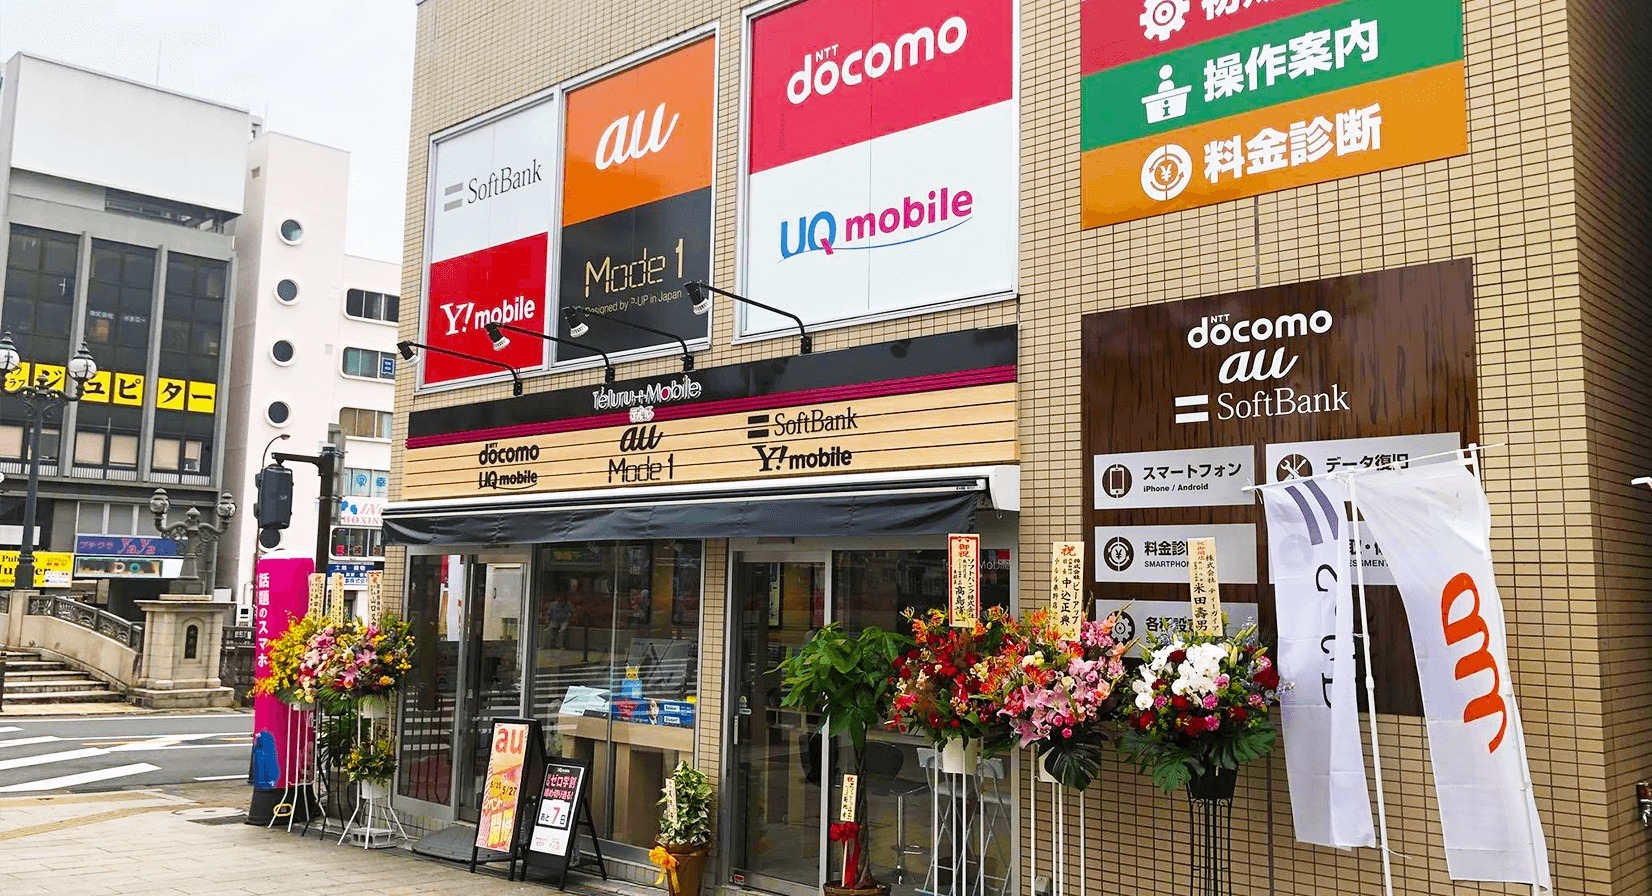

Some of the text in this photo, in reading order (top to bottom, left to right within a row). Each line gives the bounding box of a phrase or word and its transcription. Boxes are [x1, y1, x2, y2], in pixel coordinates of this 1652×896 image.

[786, 16, 968, 104] docomo
[815, 43, 839, 62] NTT
[1204, 18, 1379, 102] 操作案内
[595, 102, 680, 170] au
[1204, 103, 1382, 183] 料金診断
[467, 159, 543, 204] SoftBank
[780, 187, 973, 259] UQ mobile
[585, 238, 684, 298] Mode 1
[619, 299, 629, 312] by
[650, 293, 657, 304] in
[658, 290, 682, 305] Japan
[1187, 309, 1333, 349] docomo
[1209, 313, 1230, 324] NTT
[1218, 346, 1299, 384] au
[41, 368, 213, 404] ジュピター
[1217, 384, 1350, 421] SoftBank
[774, 406, 858, 436] SoftBank
[620, 425, 664, 452] au
[479, 444, 540, 465] docomo
[1326, 453, 1409, 472] データ復旧
[479, 470, 538, 489] UQ mobile
[608, 453, 674, 484] Mode 1
[1143, 463, 1242, 480] スマートフォン
[1178, 483, 1209, 491] Android
[342, 516, 383, 525] BOXIN
[1060, 544, 1077, 557] 祝
[1144, 541, 1188, 556] 料金診
[257, 573, 270, 668] 話題のスマホ
[495, 728, 523, 754] au
[502, 785, 517, 796] 5/27
[553, 807, 561, 824] 7
